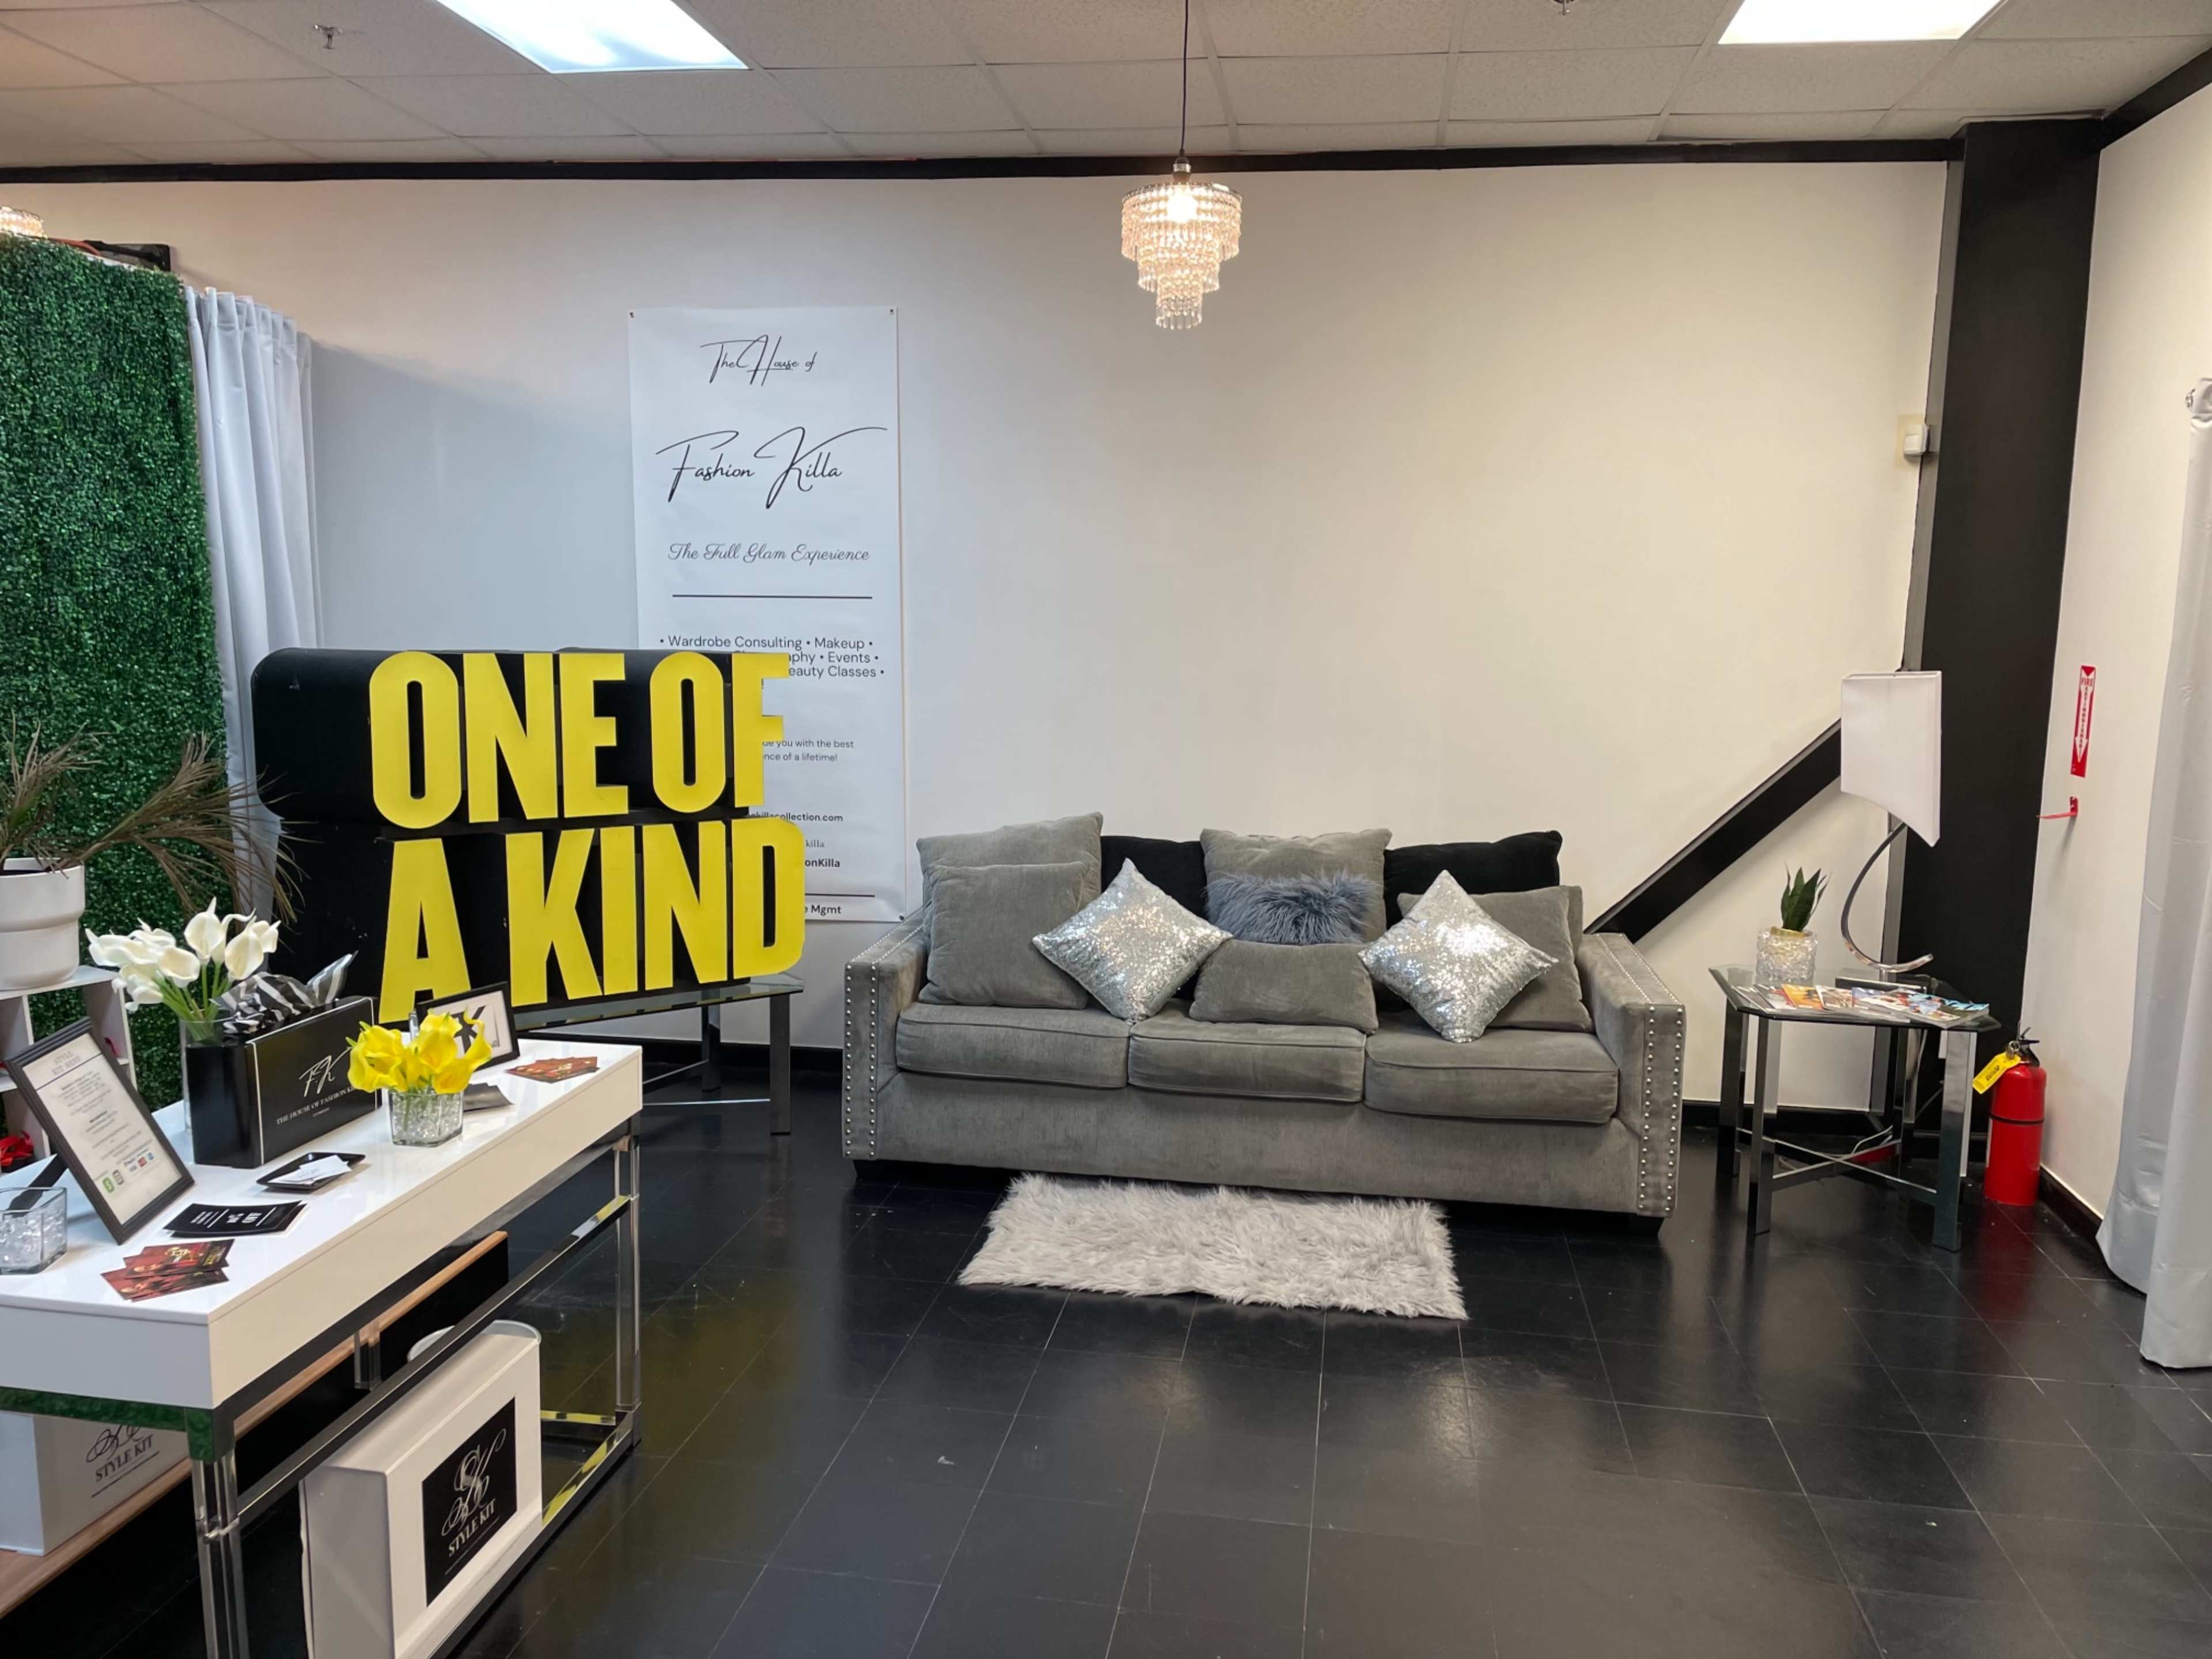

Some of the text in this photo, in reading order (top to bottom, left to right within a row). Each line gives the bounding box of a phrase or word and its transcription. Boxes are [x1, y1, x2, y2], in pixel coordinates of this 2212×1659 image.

[700, 334, 818, 386] The House of
[656, 427, 888, 509] Fashion Killa
[668, 543, 870, 566] The Full Glam Experience
[668, 636, 865, 652] Wardrobe Consulting Makeup
[827, 652, 871, 663] Events
[787, 666, 877, 679] eauty Classes
[2081, 677, 2094, 686] FIRE
[369, 652, 790, 829] ONE OF
[777, 740, 793, 748] you
[817, 740, 831, 748] the
[834, 740, 854, 748] best
[783, 752, 792, 761] of
[801, 753, 838, 762] lifetime!
[378, 818, 805, 1024] A KIND
[811, 904, 842, 916] Mgmt
[276, 1114, 289, 1125] THE
[290, 1104, 310, 1119] HOUSE
[311, 1101, 319, 1109] OF
[320, 1088, 346, 1105] FASHION
[95, 1449, 132, 1483] STYLE
[134, 1434, 153, 1457] KIT
[448, 1498, 496, 1558] STYLE KIT
